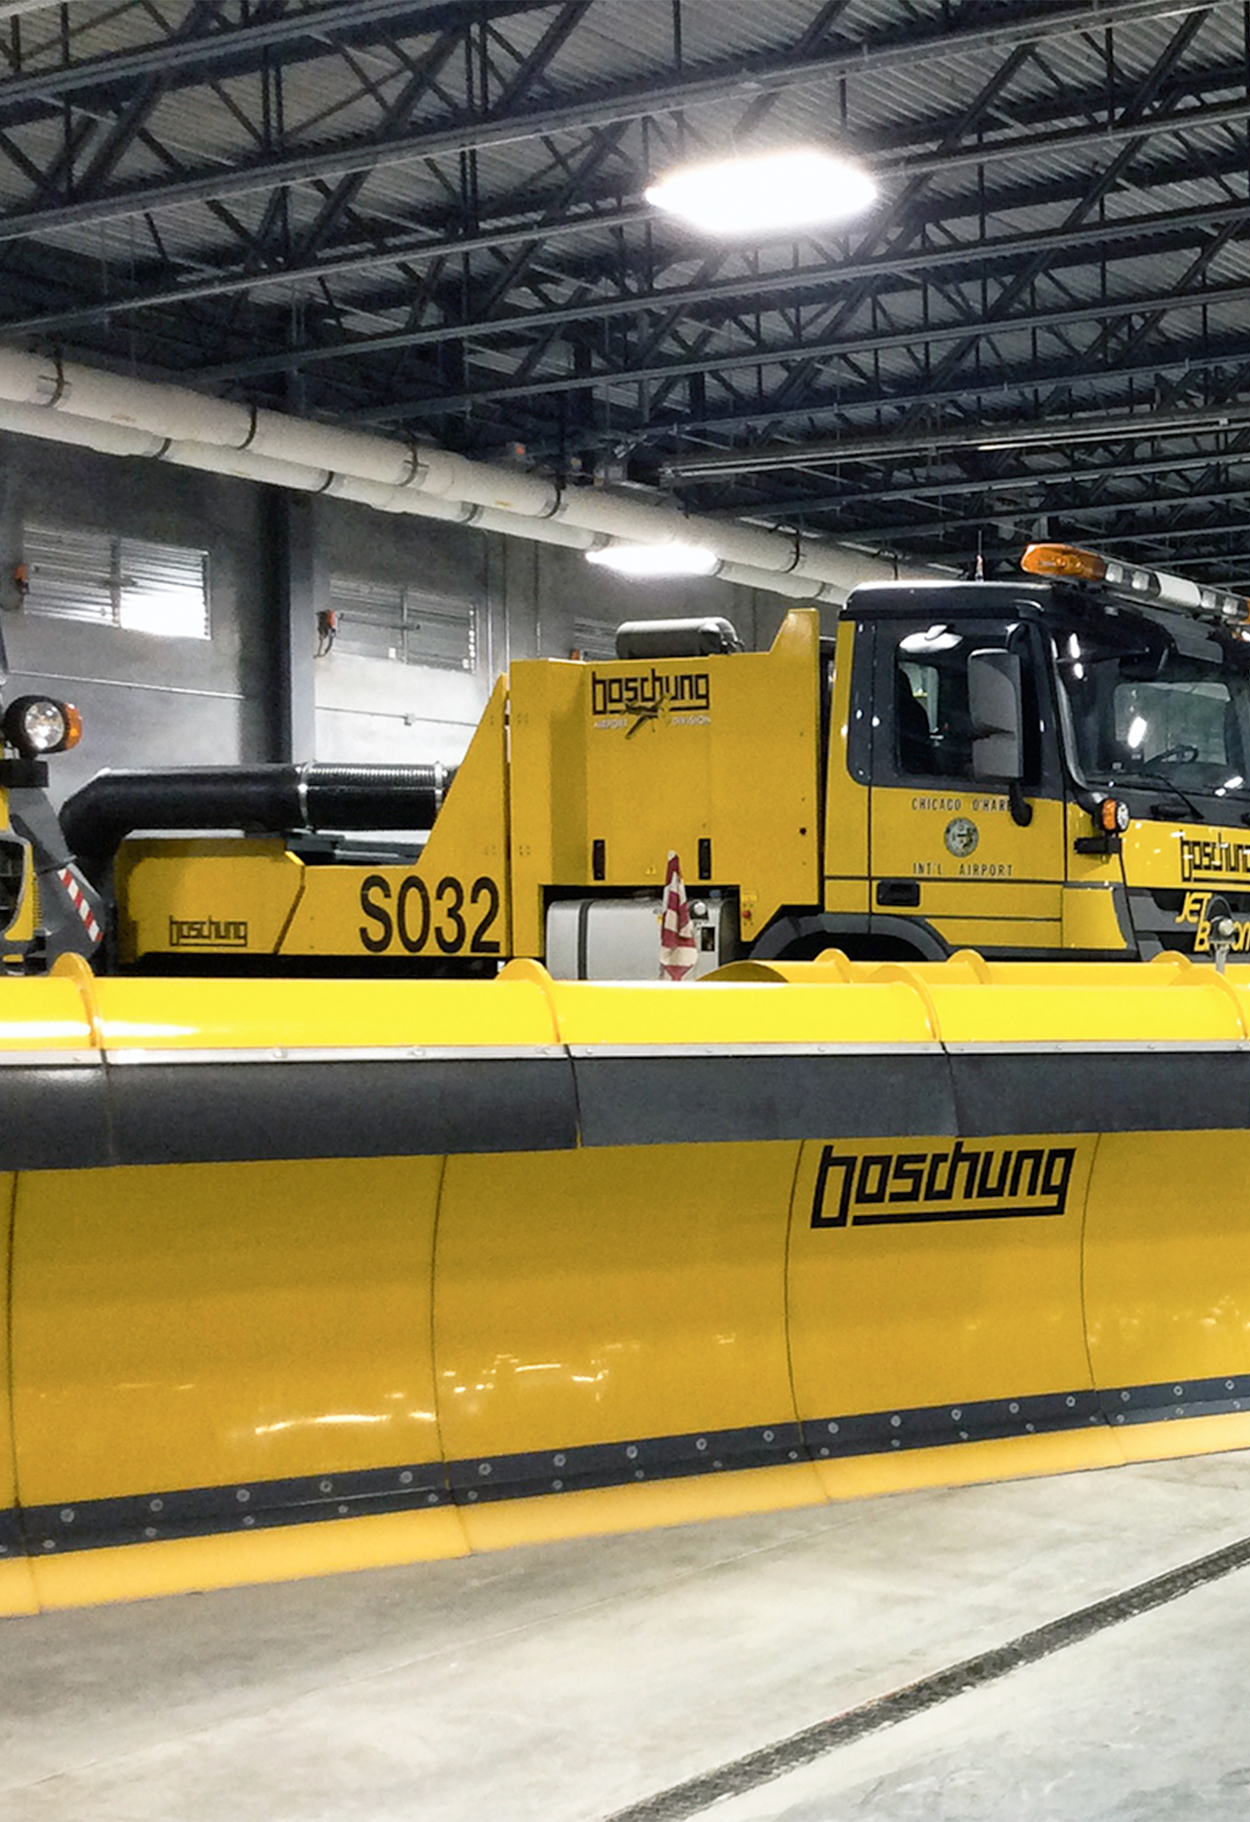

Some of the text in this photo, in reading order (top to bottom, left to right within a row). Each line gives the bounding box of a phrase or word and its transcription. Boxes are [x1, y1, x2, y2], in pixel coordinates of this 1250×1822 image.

[592, 668, 710, 715] boschung
[911, 798, 962, 811] CHICAGO
[912, 863, 1013, 877] INT'L AIRPORT
[169, 915, 248, 948] boschung
[359, 875, 500, 954] S032
[810, 1141, 1076, 1229] boschung
